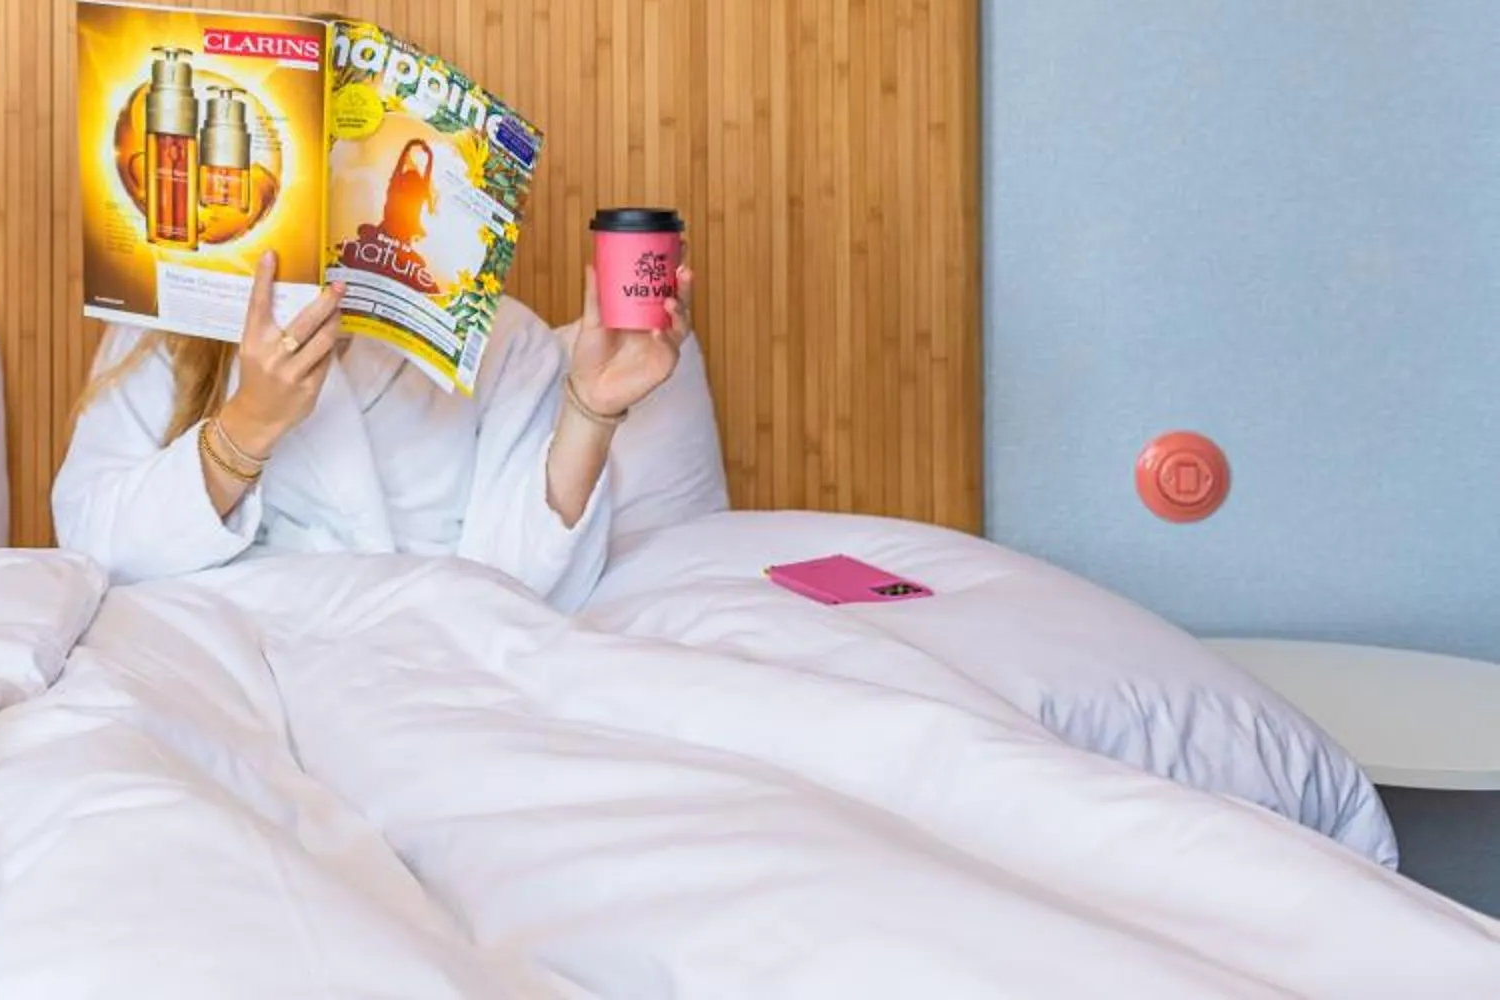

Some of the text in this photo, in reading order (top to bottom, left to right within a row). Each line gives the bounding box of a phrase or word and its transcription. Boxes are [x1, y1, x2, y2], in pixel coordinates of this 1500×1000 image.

[204, 32, 319, 59] CLARINS
[342, 239, 435, 287] nature
[622, 283, 649, 297] via
